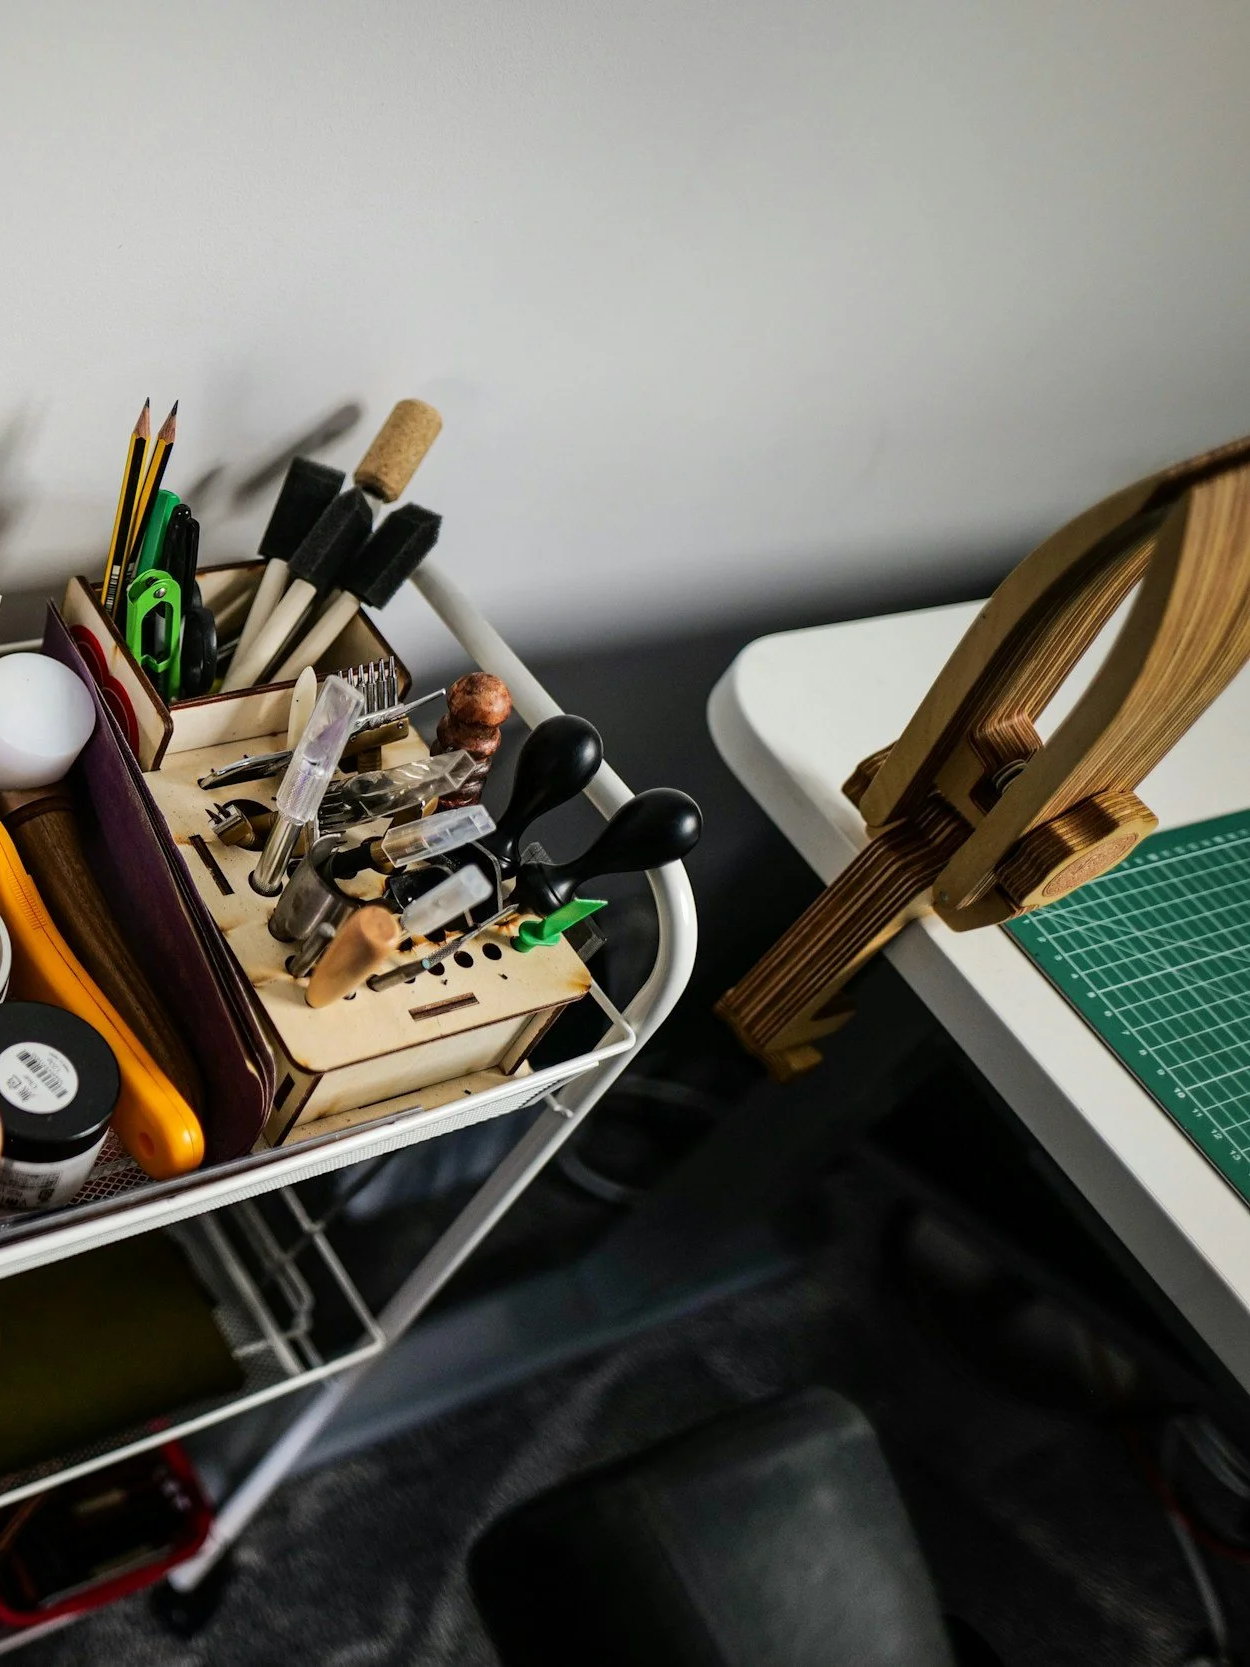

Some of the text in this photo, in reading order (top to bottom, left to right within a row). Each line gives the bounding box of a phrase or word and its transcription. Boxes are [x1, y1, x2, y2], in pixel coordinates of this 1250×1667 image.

[1174, 1087, 1186, 1098] 10
[1192, 1108, 1203, 1118] 11
[1211, 1128, 1223, 1140] 12
[1230, 1149, 1242, 1161] 13
